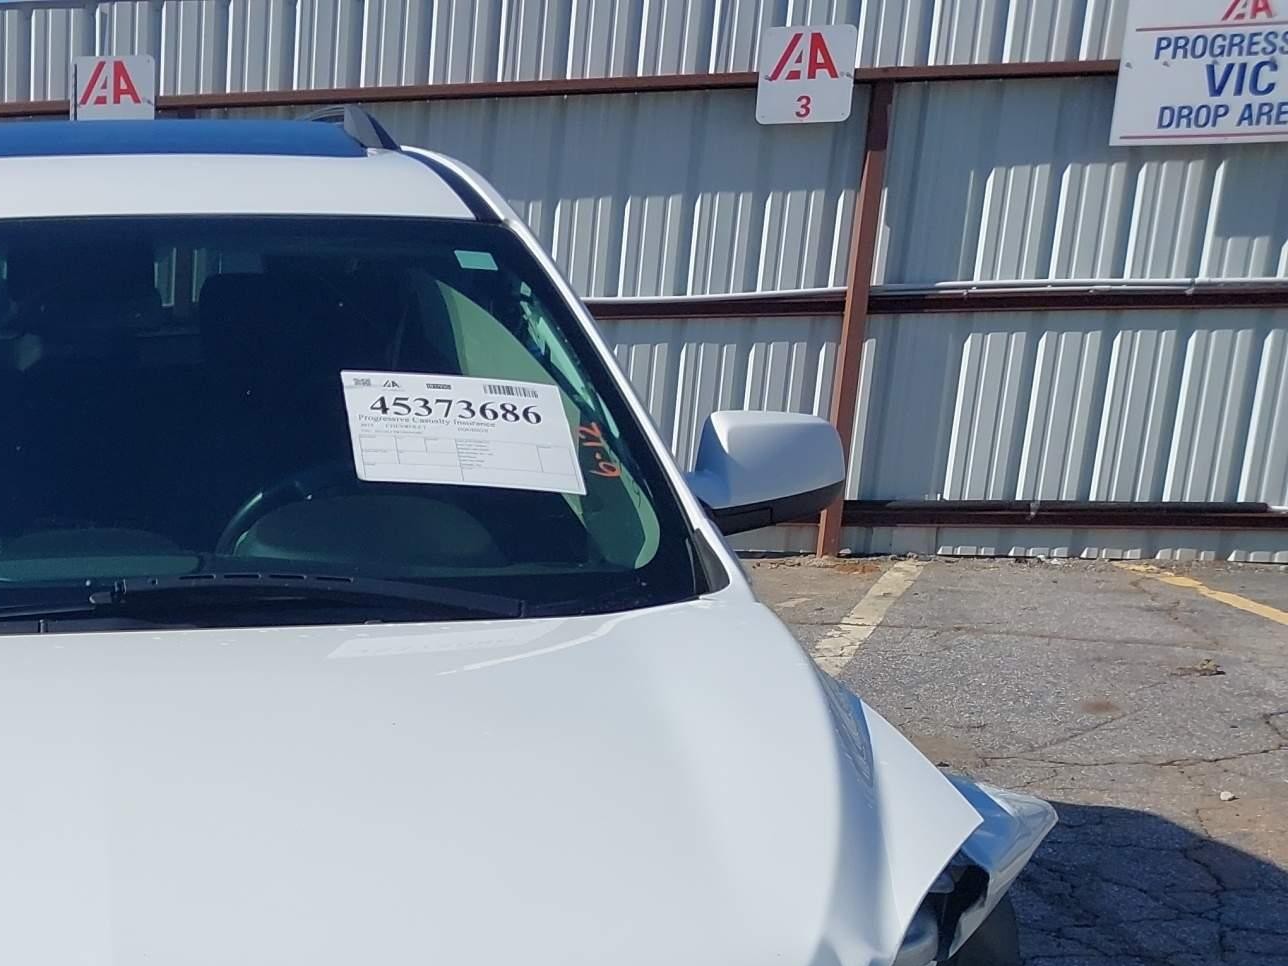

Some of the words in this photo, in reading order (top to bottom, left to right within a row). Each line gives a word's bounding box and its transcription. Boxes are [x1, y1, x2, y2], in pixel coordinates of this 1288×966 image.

[1206, 60, 1279, 97] VIC
[795, 95, 812, 118] 3
[1157, 104, 1230, 129] DROP
[1235, 102, 1288, 127] ARE
[370, 396, 542, 425] 45373686
